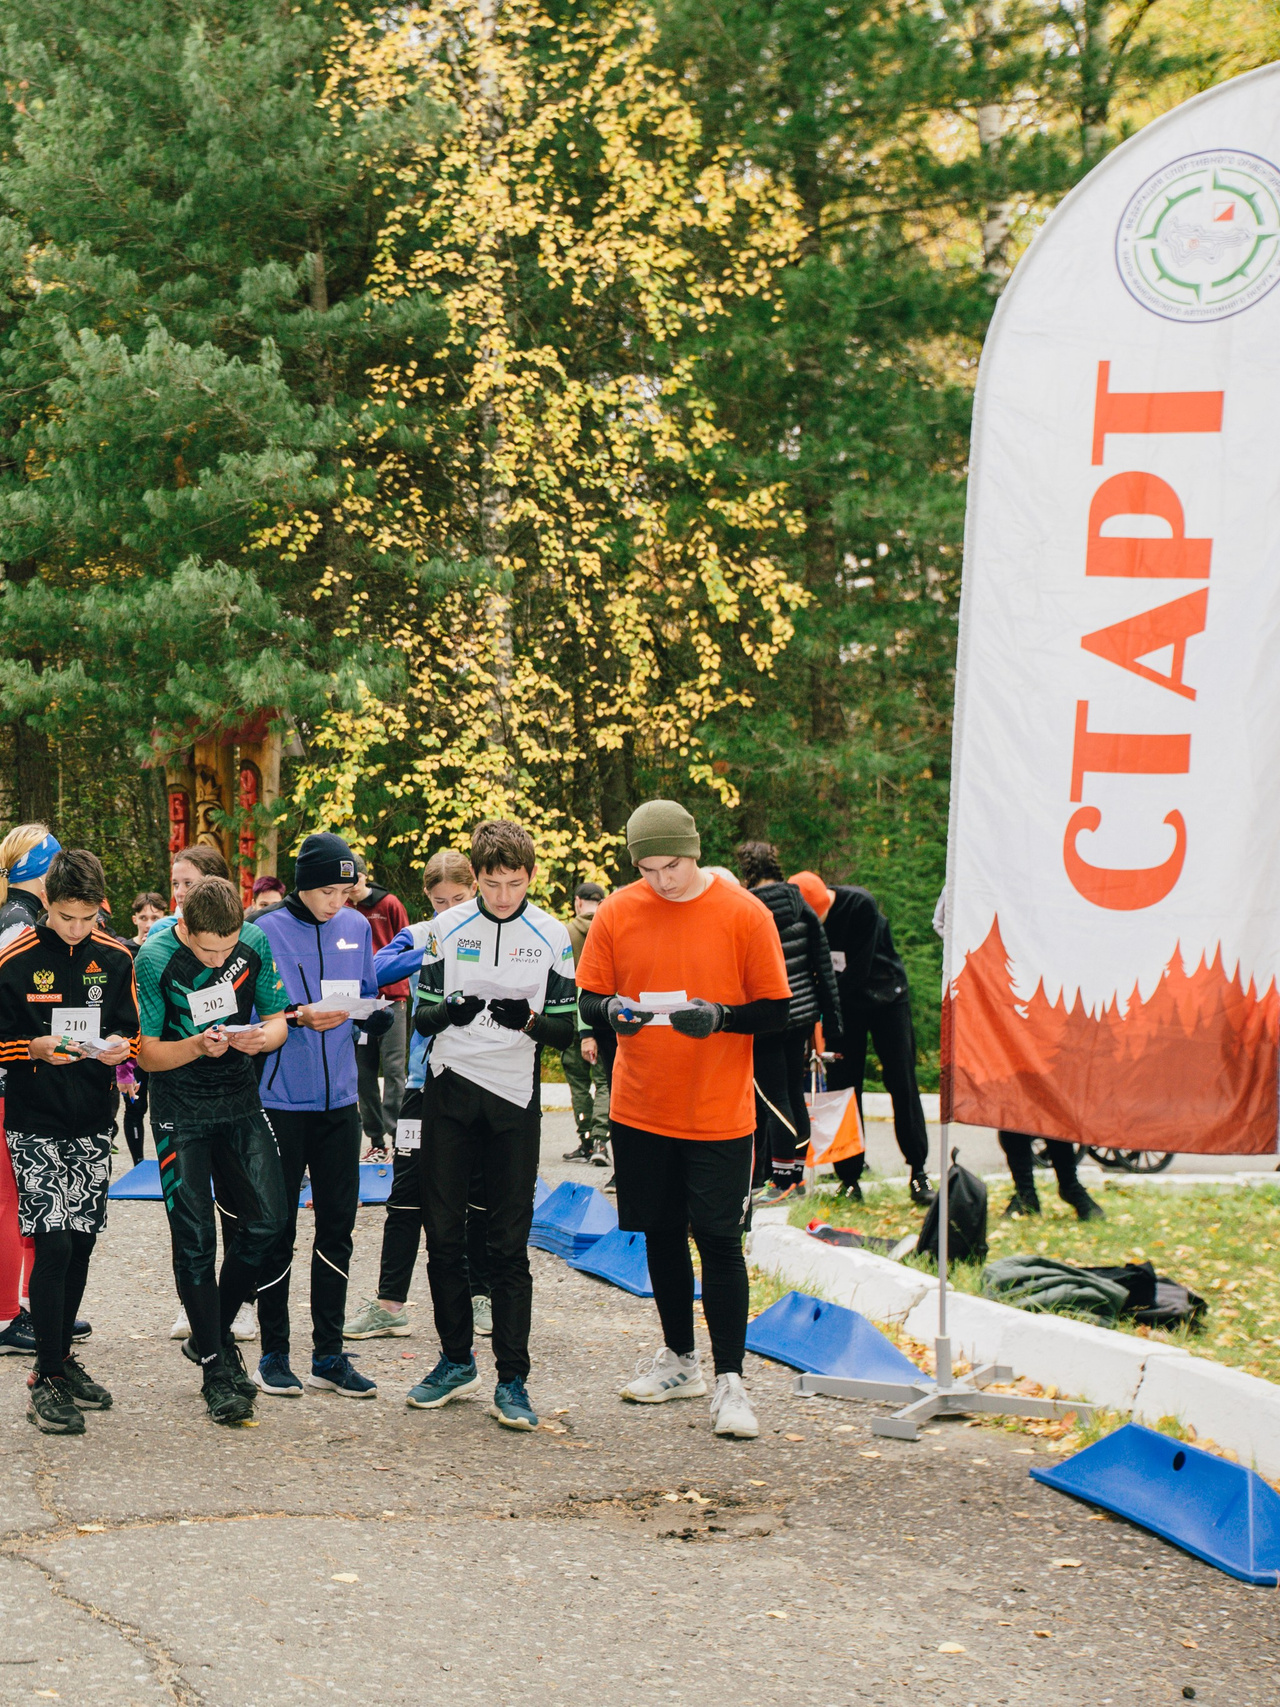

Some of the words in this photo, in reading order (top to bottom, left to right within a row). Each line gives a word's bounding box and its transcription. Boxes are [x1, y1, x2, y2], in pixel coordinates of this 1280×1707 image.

[1063, 360, 1225, 911] СТАРТ
[82, 974, 108, 985] htc
[203, 997, 225, 1013] 202
[64, 1020, 87, 1032] 210
